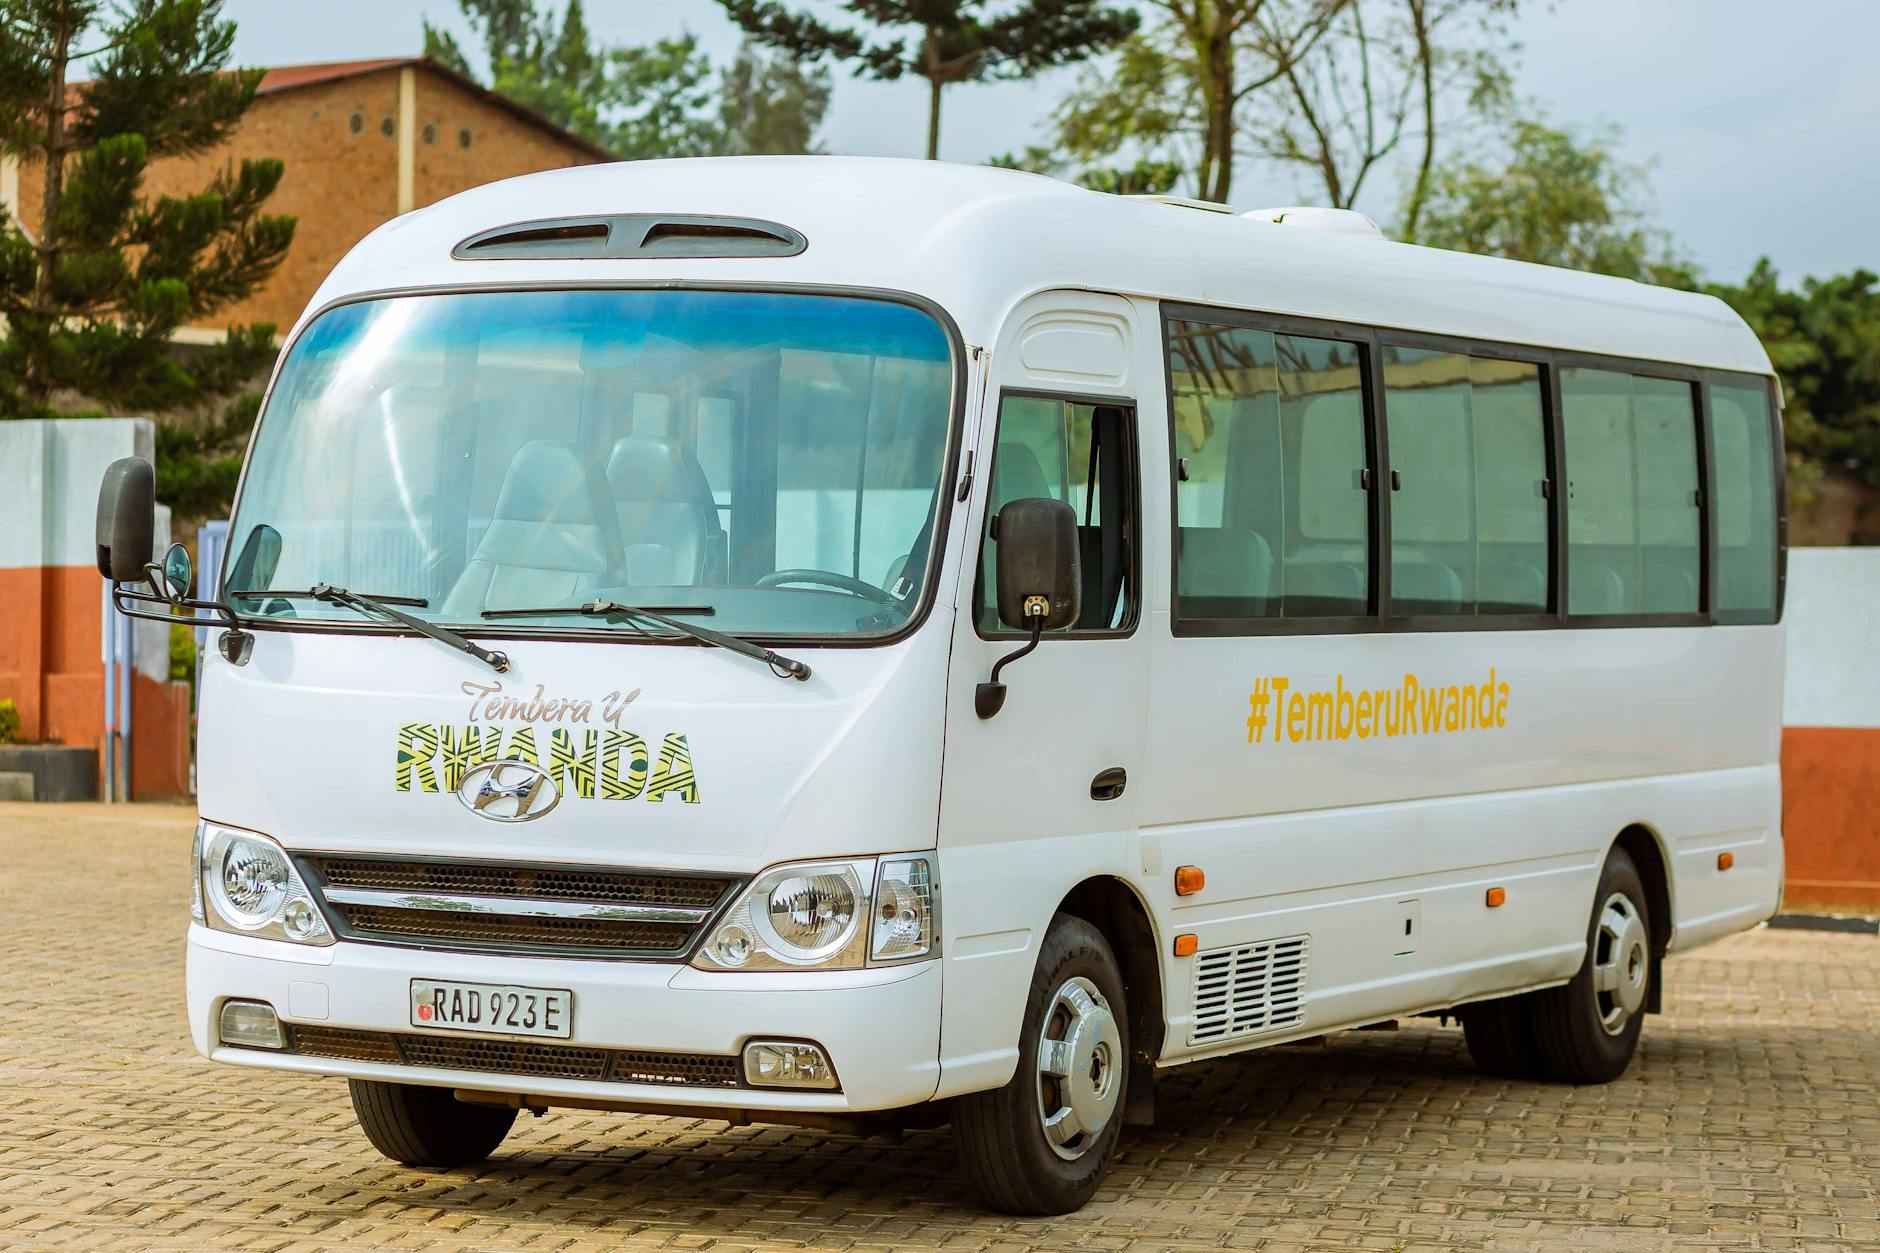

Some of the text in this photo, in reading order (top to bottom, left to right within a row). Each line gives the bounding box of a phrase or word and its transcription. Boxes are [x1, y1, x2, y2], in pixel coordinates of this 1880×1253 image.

[461, 680, 591, 723] Tembera
[1247, 667, 1510, 743] #TemberuRwanda
[432, 988, 560, 1031] RAD 923 E
